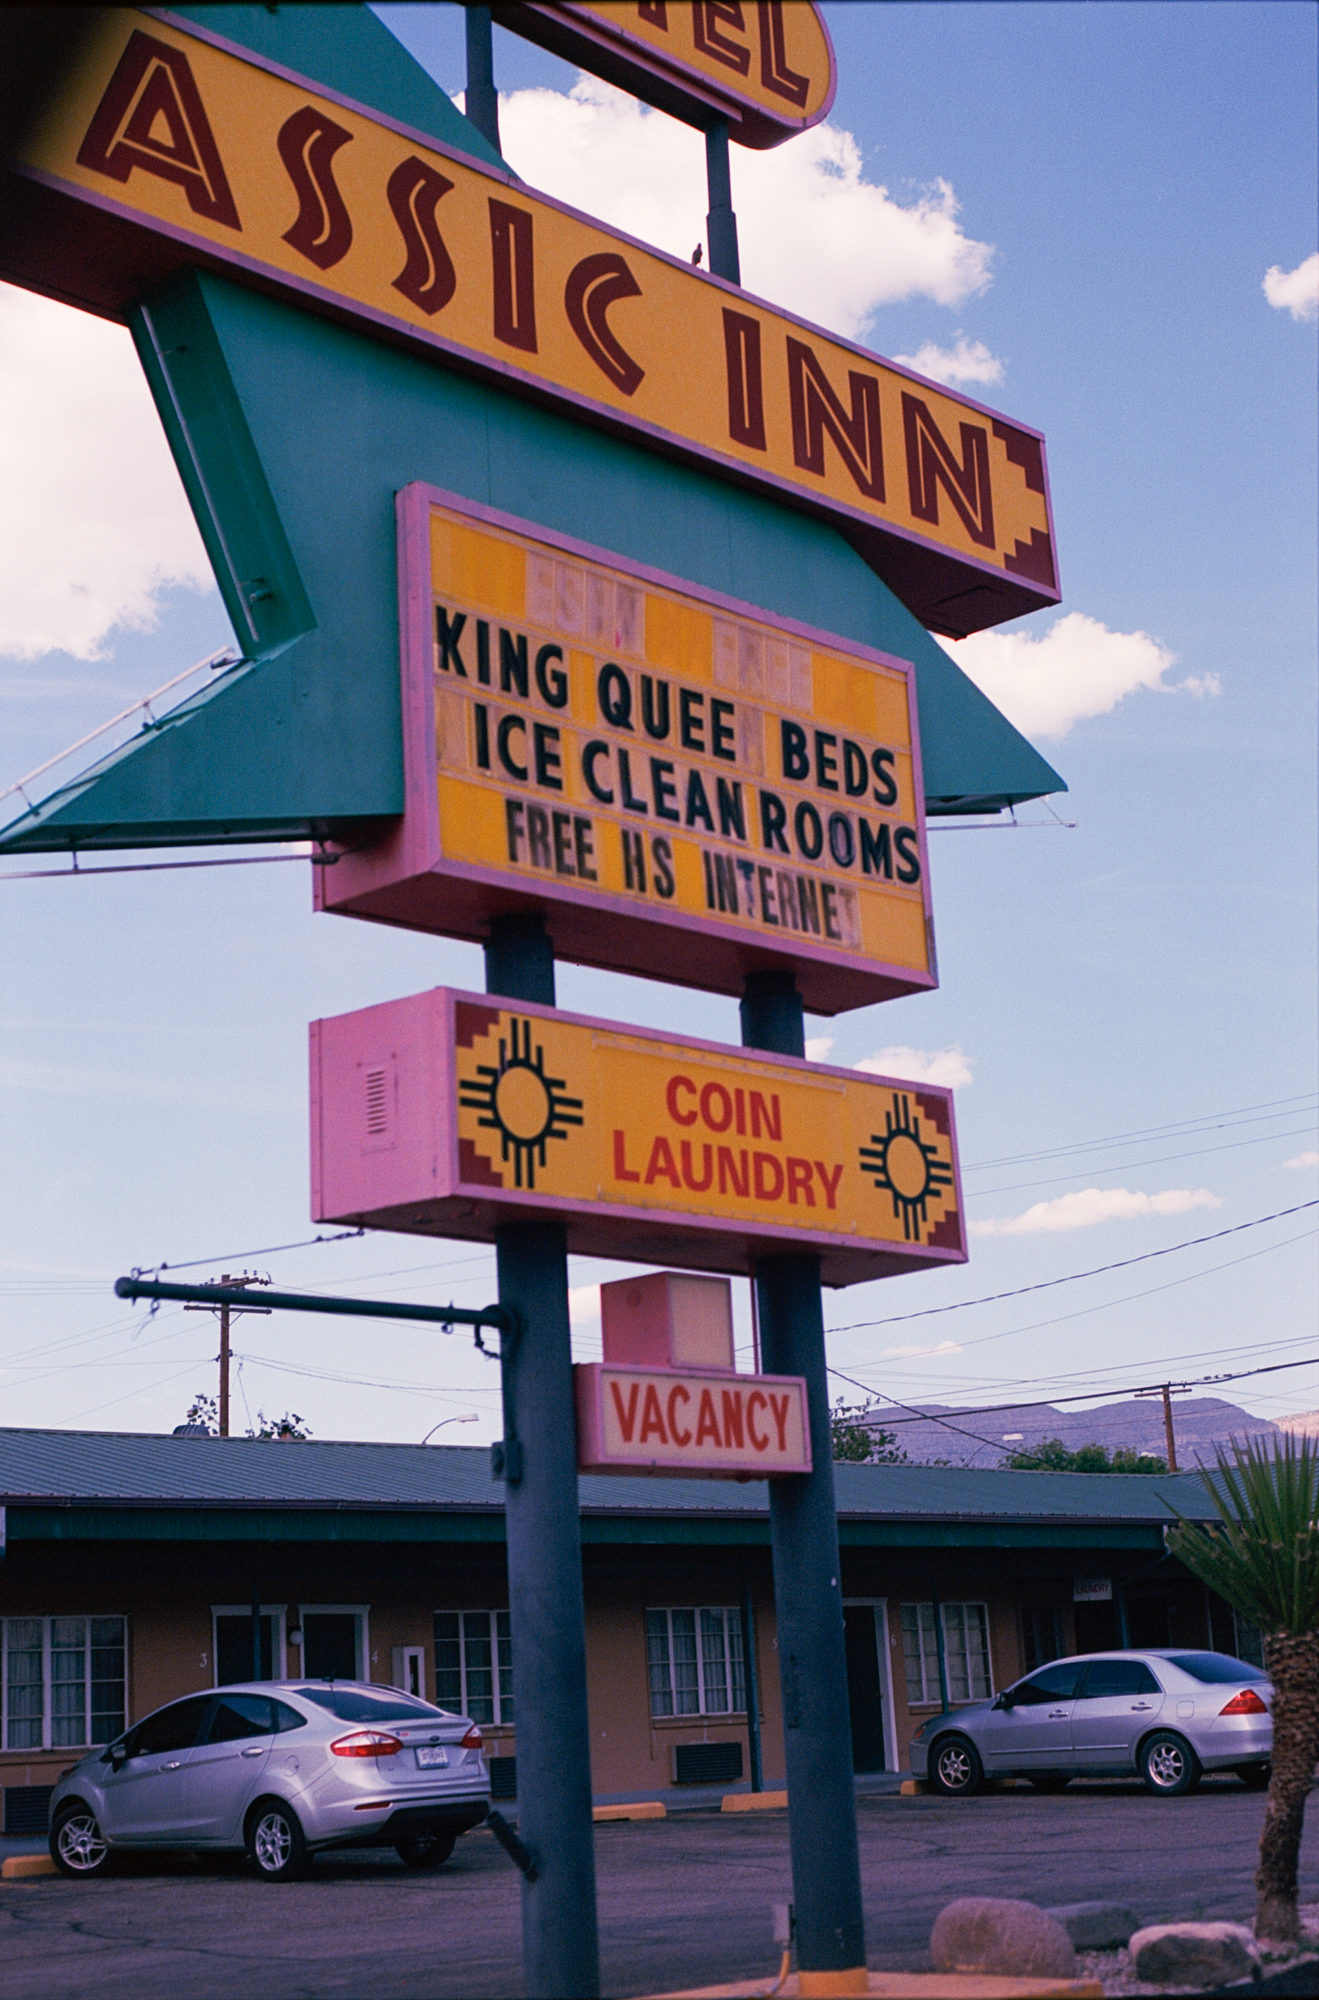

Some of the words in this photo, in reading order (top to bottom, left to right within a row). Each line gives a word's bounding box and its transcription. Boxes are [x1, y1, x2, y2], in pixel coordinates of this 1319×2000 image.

[638, 1, 810, 109] EL
[76, 29, 646, 397] ASSIC
[722, 306, 996, 551] INN
[436, 604, 569, 709] KING
[781, 718, 898, 807] BEDS
[475, 702, 563, 790] ICE
[582, 740, 747, 841] CLEAN
[759, 789, 921, 884] ROOMS
[505, 798, 598, 882] FREE
[621, 829, 675, 899] HS
[703, 850, 863, 946] INTERNET
[665, 1075, 783, 1142] COIN
[613, 1130, 844, 1210] LAUNDRY
[609, 1381, 790, 1452] VACANCY
[1075, 1582, 1110, 1594] LAUNDRY
[200, 1653, 208, 1668] 3
[371, 1650, 378, 1664] 4
